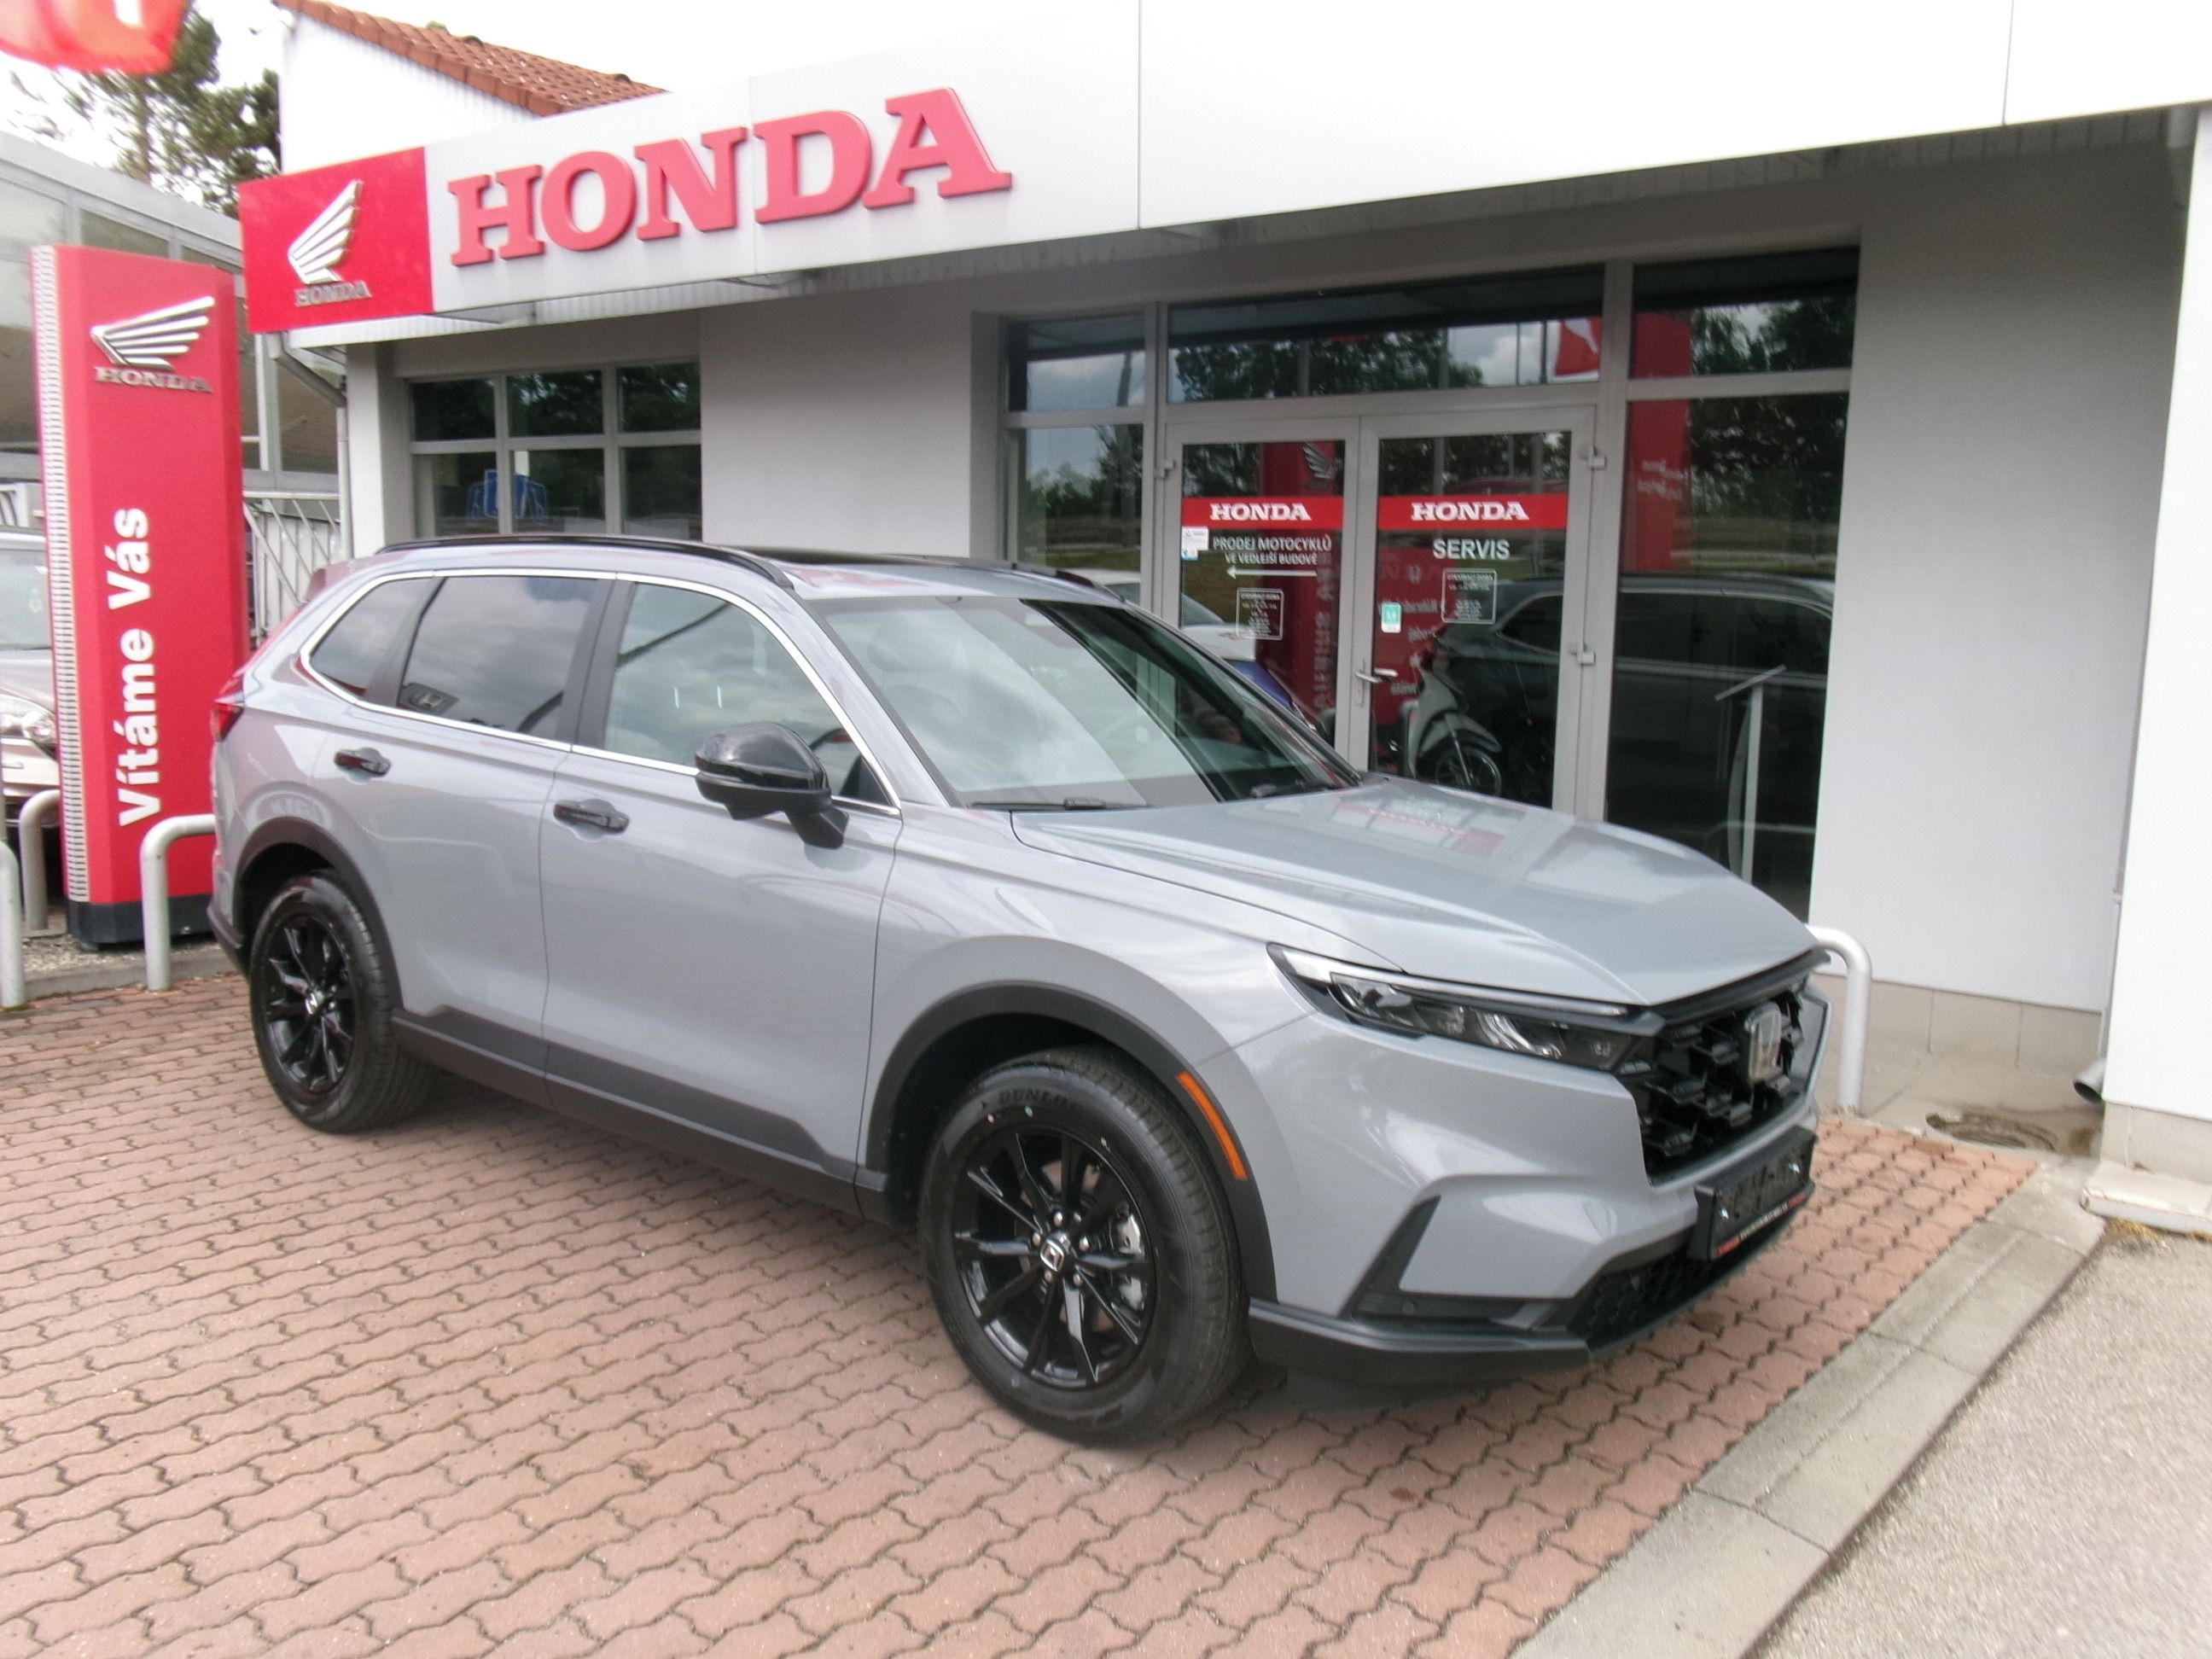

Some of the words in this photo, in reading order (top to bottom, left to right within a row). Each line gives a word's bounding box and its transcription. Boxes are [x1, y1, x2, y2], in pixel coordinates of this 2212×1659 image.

[448, 87, 1011, 267] HONDA
[294, 280, 372, 306] HONDA
[95, 366, 212, 393] HONDA
[1210, 503, 1312, 521] HONDA
[1411, 501, 1529, 521] HONDA
[1213, 536, 1256, 550] PRODEJ
[1433, 538, 1510, 560] SERVIS
[105, 508, 151, 610] Vás
[1225, 552, 1237, 564] VE
[114, 628, 161, 826] Vítáme
